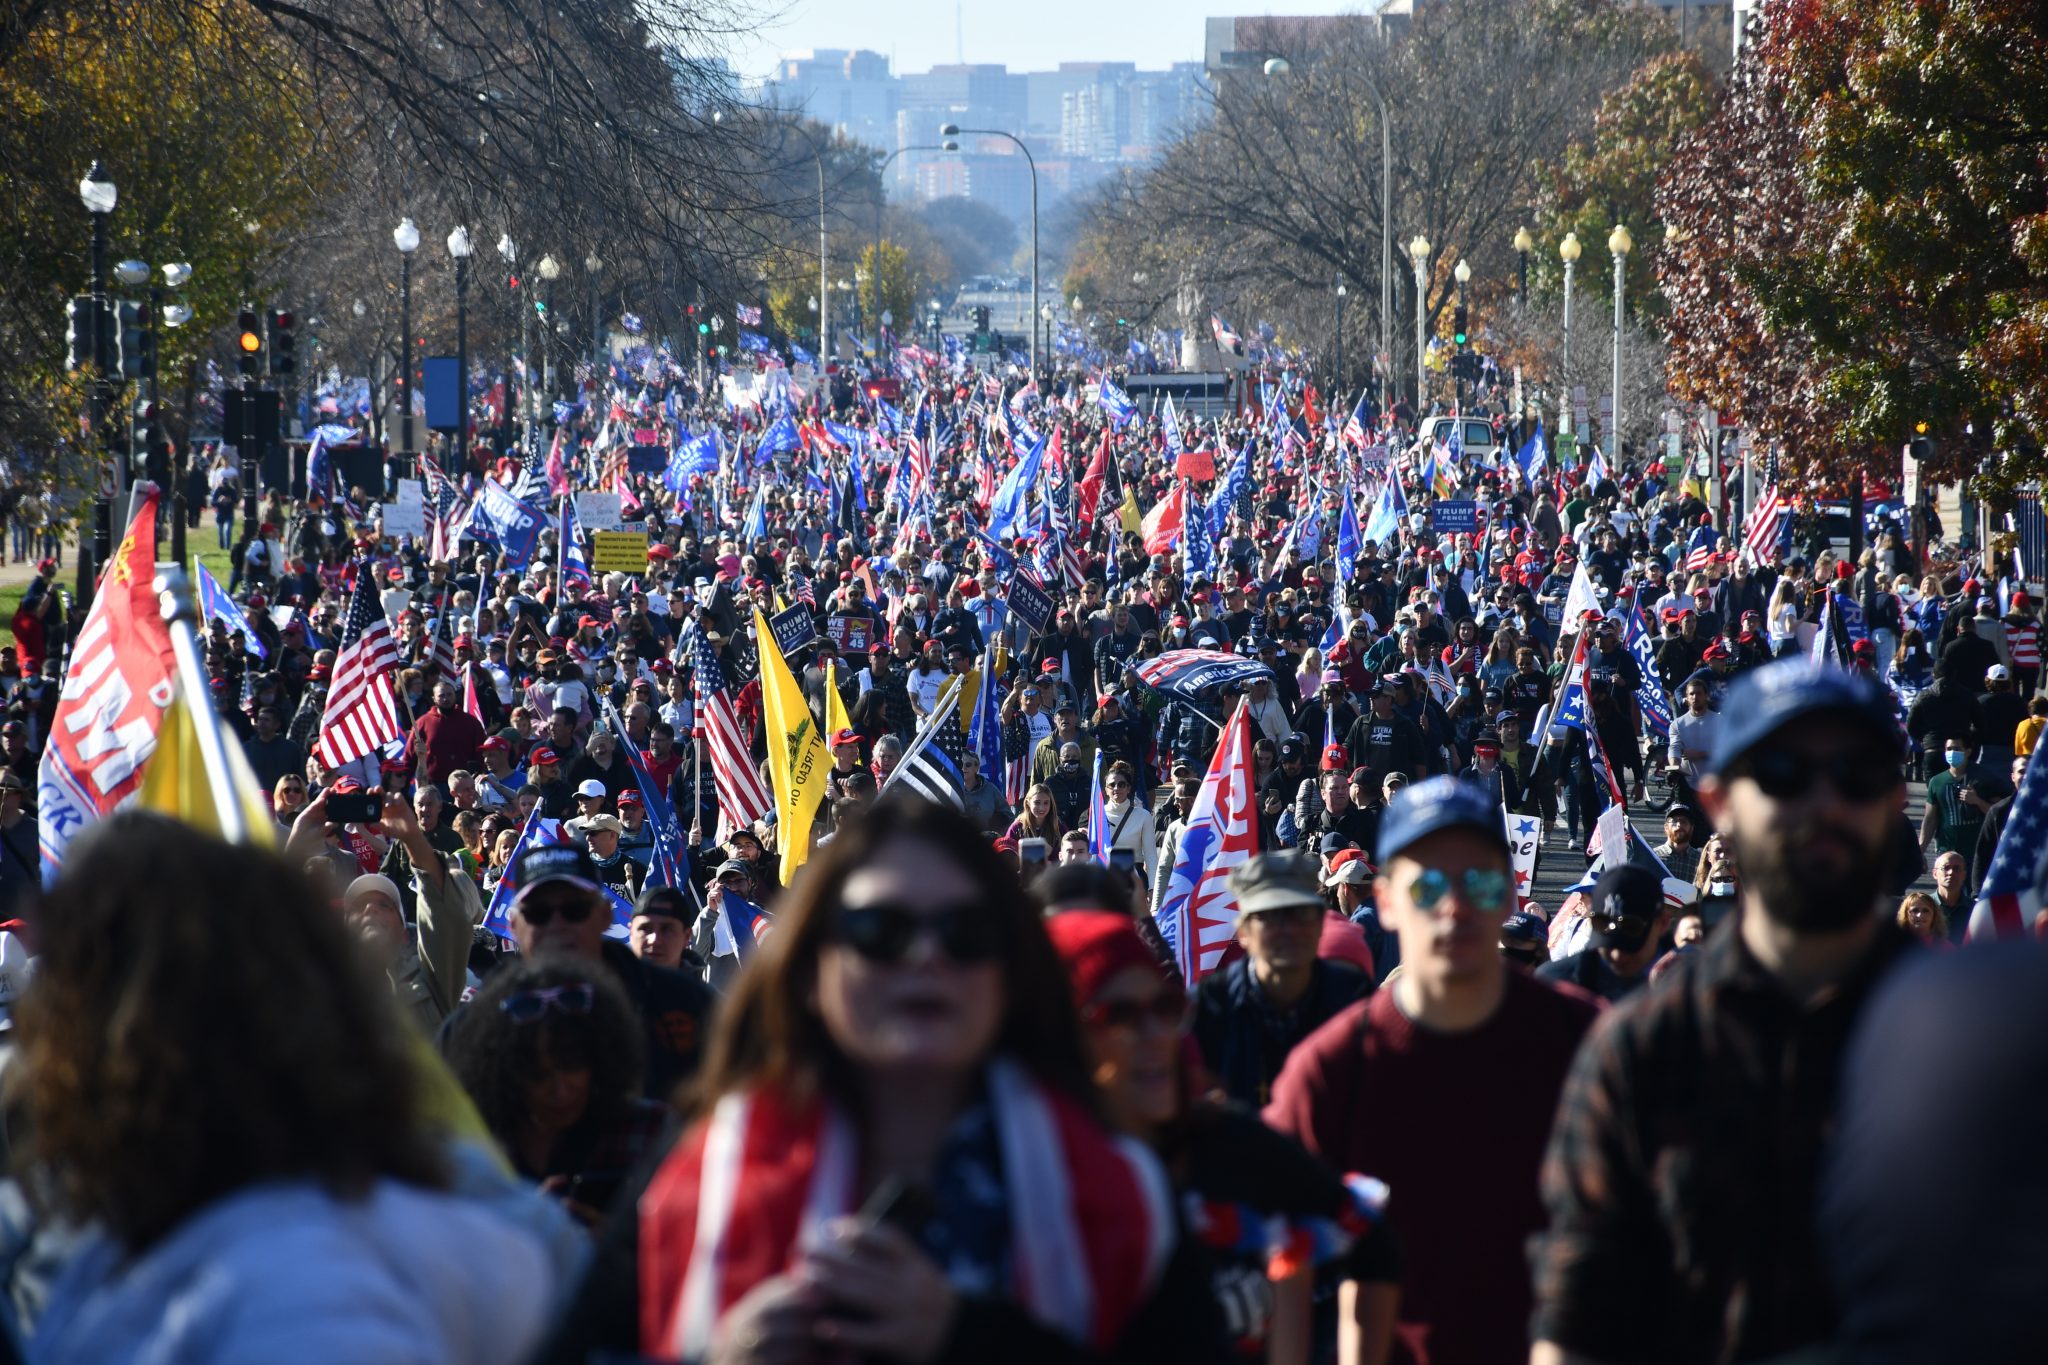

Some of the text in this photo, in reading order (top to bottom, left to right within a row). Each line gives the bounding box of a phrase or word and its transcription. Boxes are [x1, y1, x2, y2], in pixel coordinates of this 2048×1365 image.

[1436, 507, 1474, 515] TRUMP
[1015, 580, 1049, 614] TRUMP
[1016, 591, 1044, 618] PENCE
[775, 611, 808, 636] TRUMP
[782, 621, 808, 640] PENCE
[827, 617, 846, 628] WE
[848, 638, 865, 648] 45
[1634, 619, 1661, 678] TRU
[1183, 666, 1237, 696] America
[1563, 712, 1576, 721] For
[1373, 726, 1393, 735] ETERA
[1327, 750, 1342, 759] USA
[525, 849, 579, 870] TRUMP
